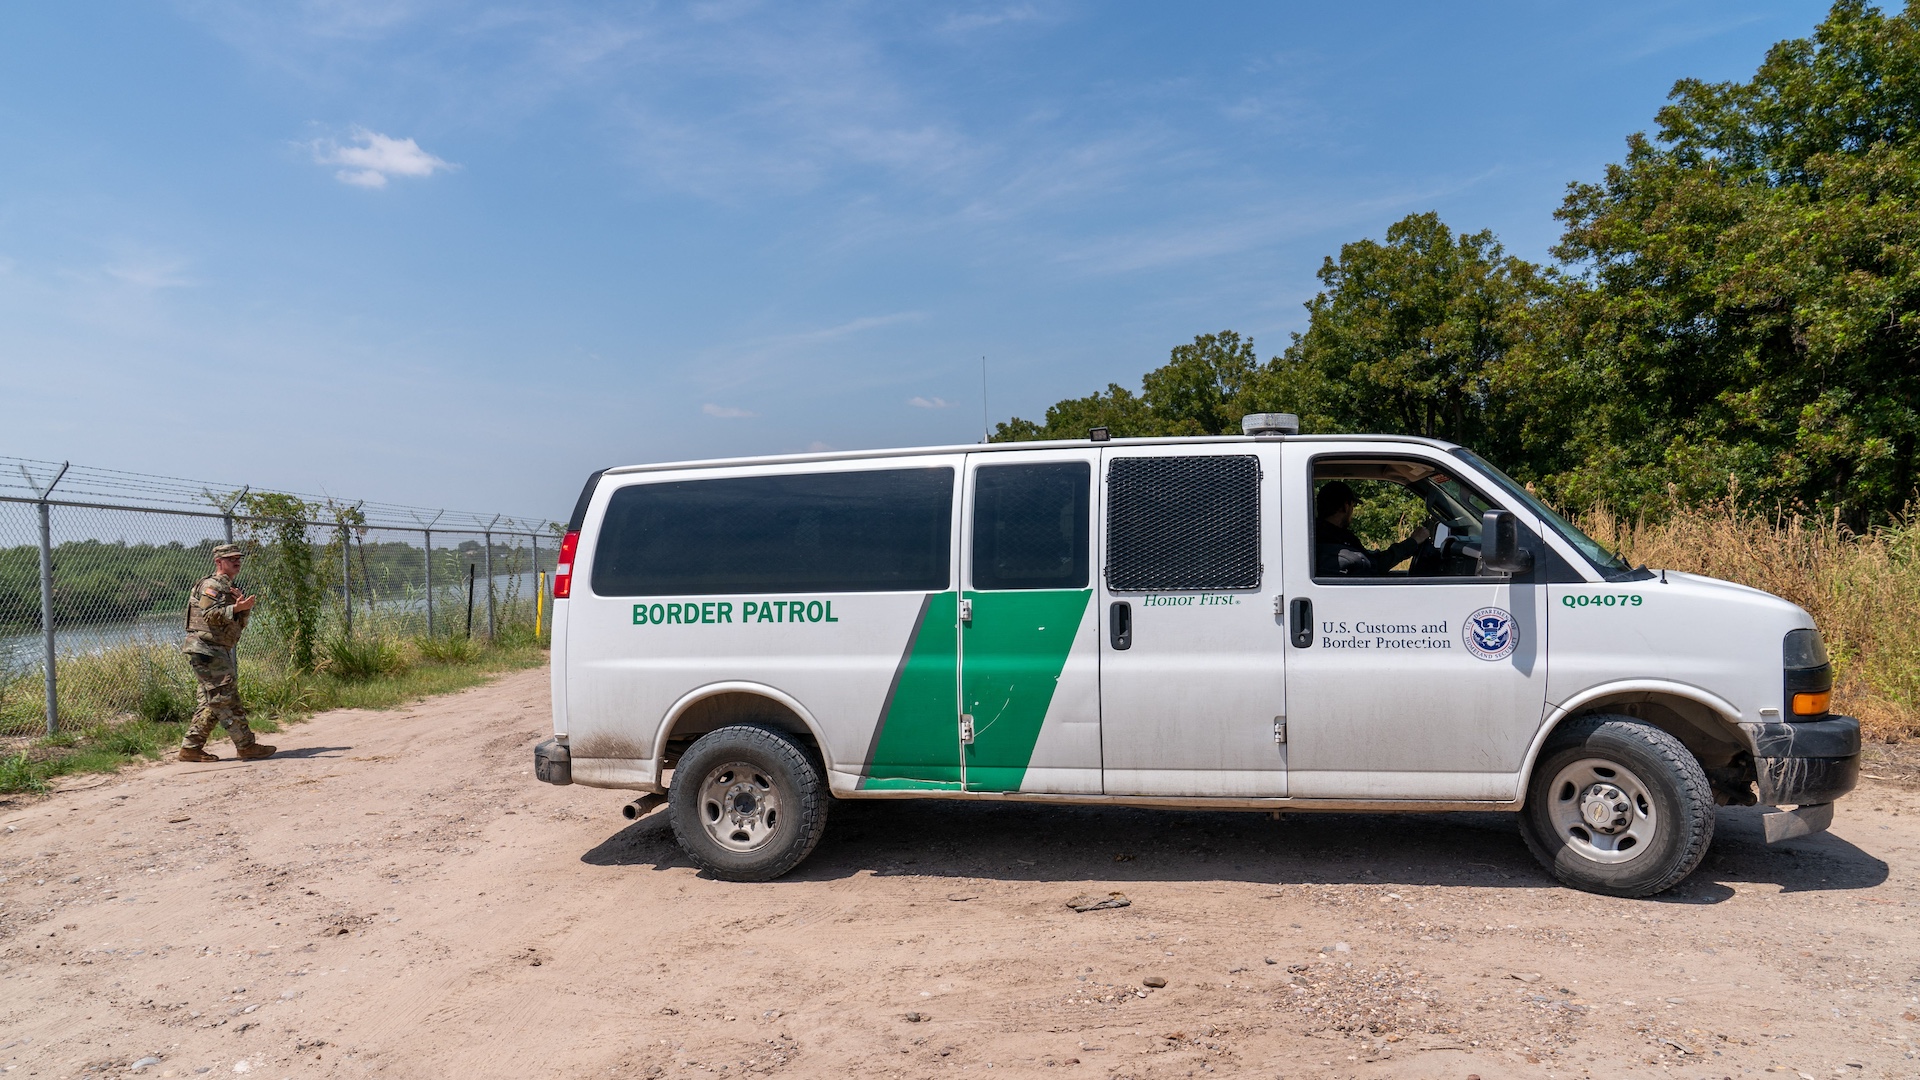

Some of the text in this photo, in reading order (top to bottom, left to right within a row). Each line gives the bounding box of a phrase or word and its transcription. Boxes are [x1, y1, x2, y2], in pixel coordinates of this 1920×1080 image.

[1143, 594, 1195, 607] Honor
[1562, 594, 1643, 609] Q04079
[632, 600, 839, 625] BORDER PATROL
[1322, 620, 1448, 634] U.S. Customs and
[1322, 635, 1452, 649] Border Protection
